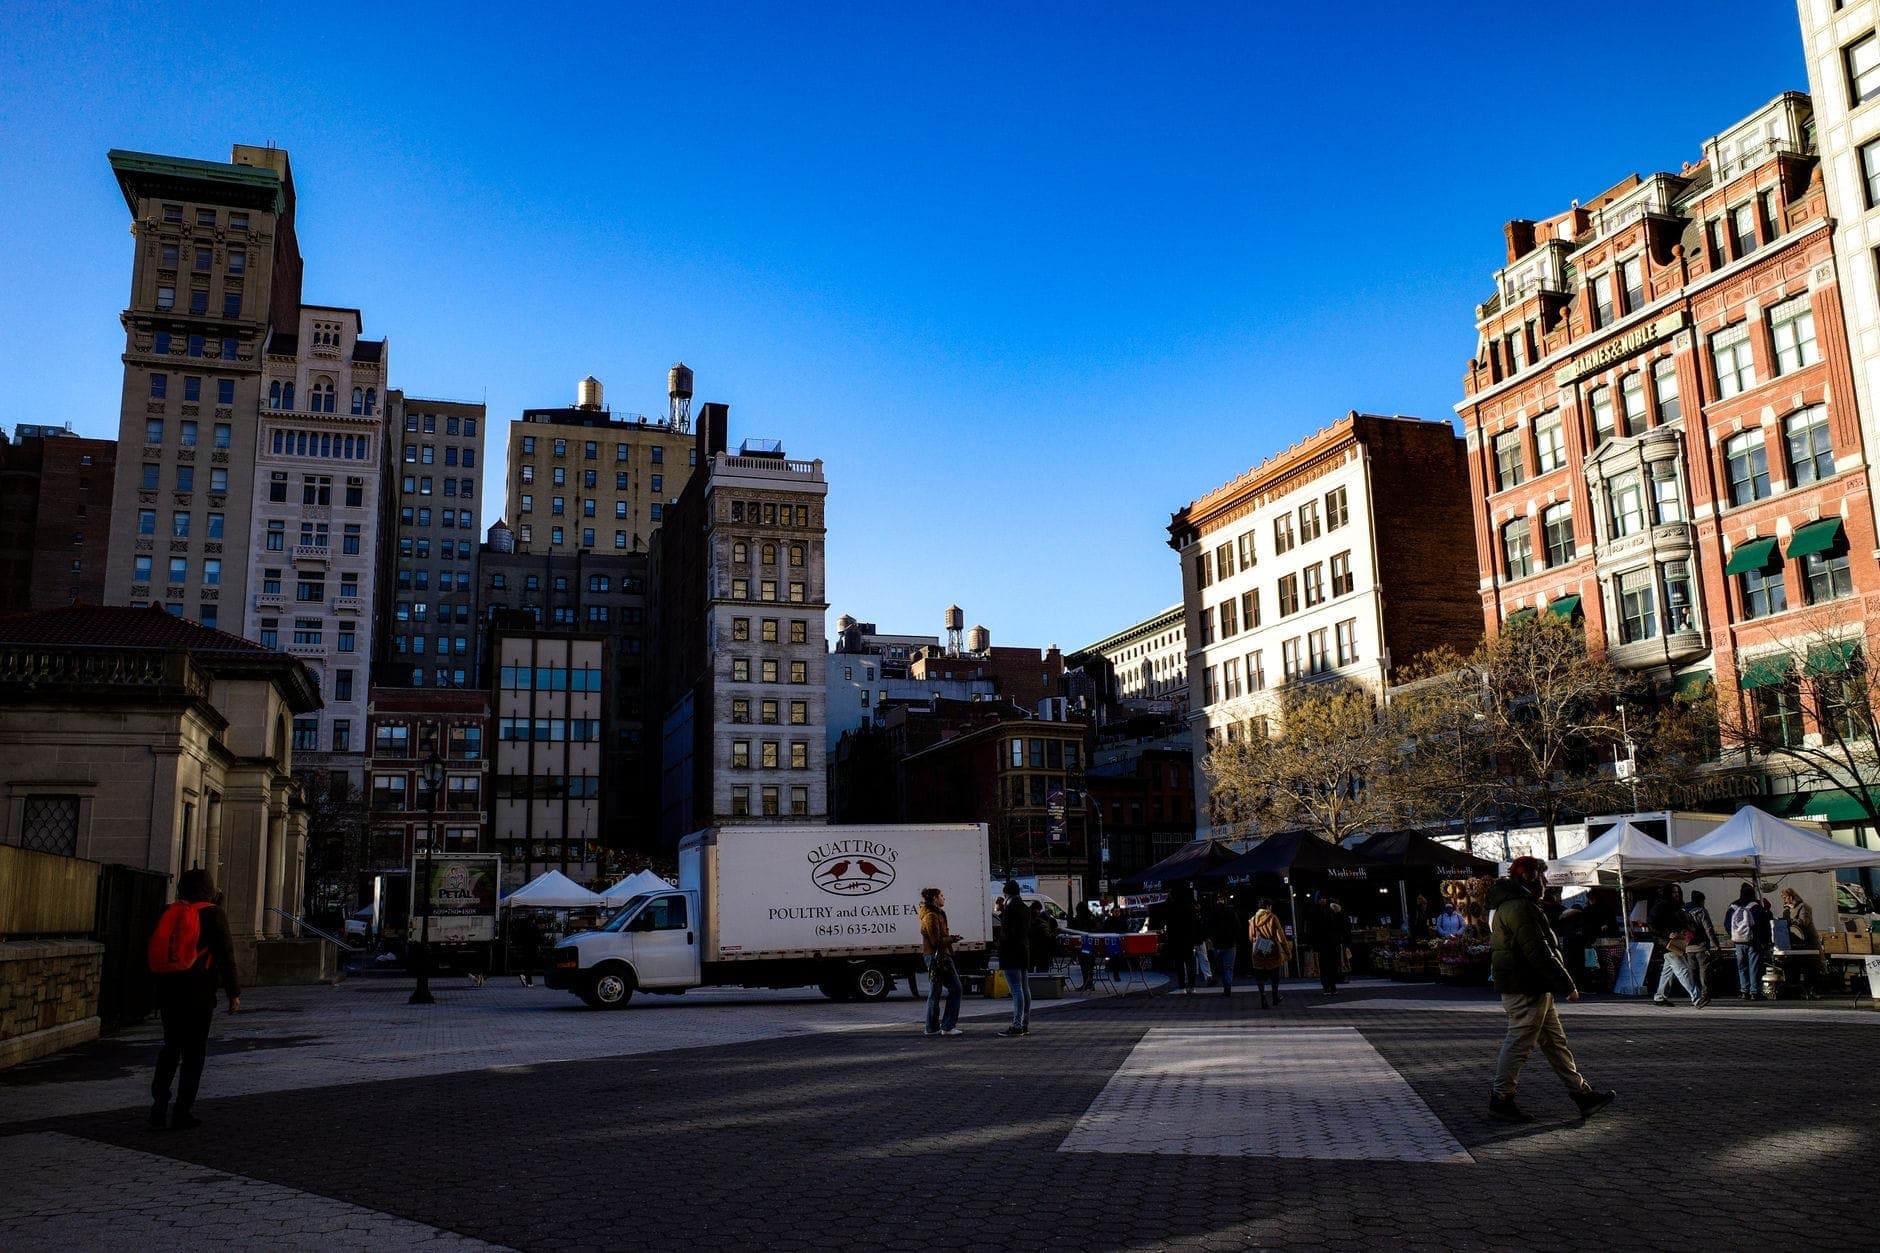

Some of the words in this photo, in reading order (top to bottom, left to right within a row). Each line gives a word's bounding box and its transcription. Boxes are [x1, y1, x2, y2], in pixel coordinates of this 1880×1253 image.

[807, 840, 898, 866] QUATTRO'S
[768, 906, 833, 920] POULTRY
[836, 906, 858, 918] and
[860, 904, 900, 918] GAME
[903, 903, 919, 915] FA
[815, 924, 844, 938] (845)
[847, 923, 897, 936] 635-2018
